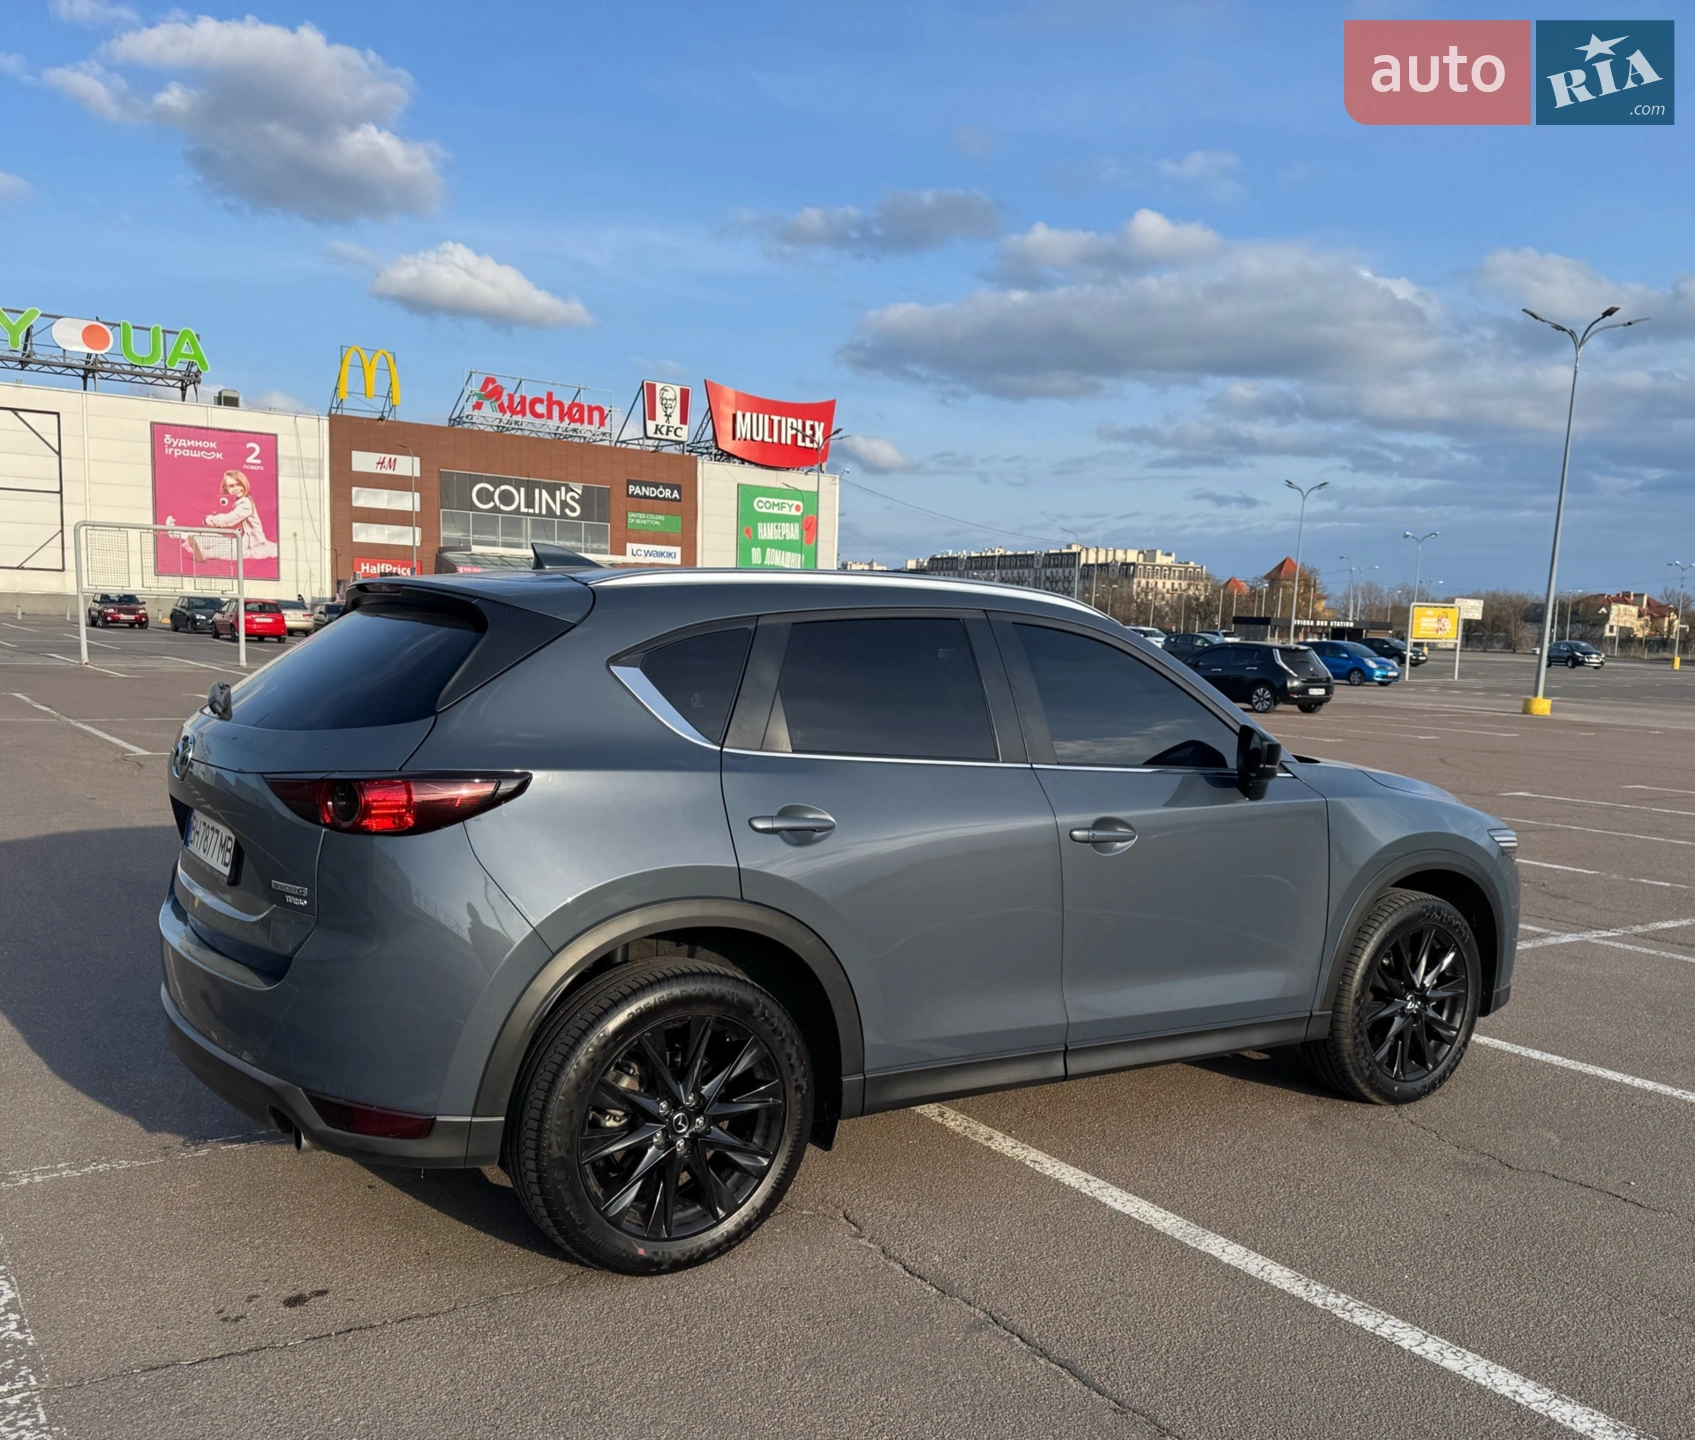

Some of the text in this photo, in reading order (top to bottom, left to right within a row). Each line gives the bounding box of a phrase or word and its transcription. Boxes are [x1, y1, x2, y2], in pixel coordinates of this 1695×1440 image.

[119, 319, 210, 373] UA
[472, 375, 607, 428] Auchan
[653, 423, 684, 438] KFC
[734, 410, 826, 450] MULTIPLEX
[163, 433, 218, 450] будинок
[246, 442, 262, 465] 2
[375, 456, 398, 472] H&M
[471, 481, 582, 518] COLIN'S
[756, 499, 794, 513] COMFY
[757, 521, 800, 541] НАМБЕРВАН
[631, 548, 643, 557] LC
[751, 547, 762, 564] ПО
